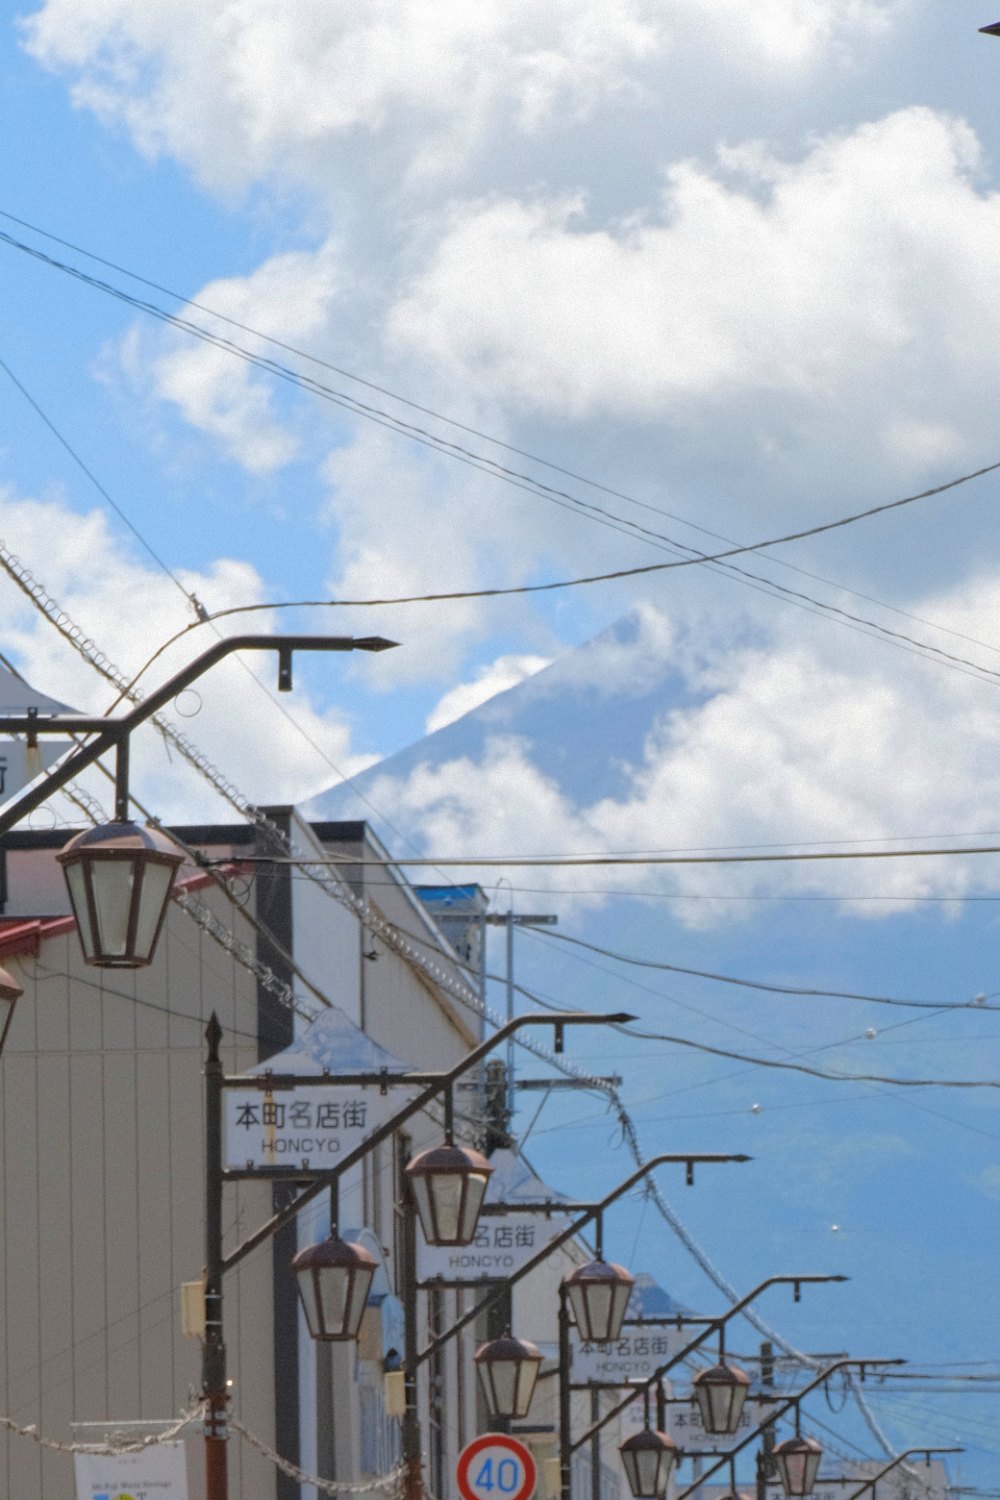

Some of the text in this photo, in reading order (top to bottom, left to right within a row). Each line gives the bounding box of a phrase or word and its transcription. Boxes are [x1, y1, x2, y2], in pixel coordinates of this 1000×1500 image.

[235, 1101, 367, 1130] 本町名店街
[475, 1459, 519, 1494] 40
